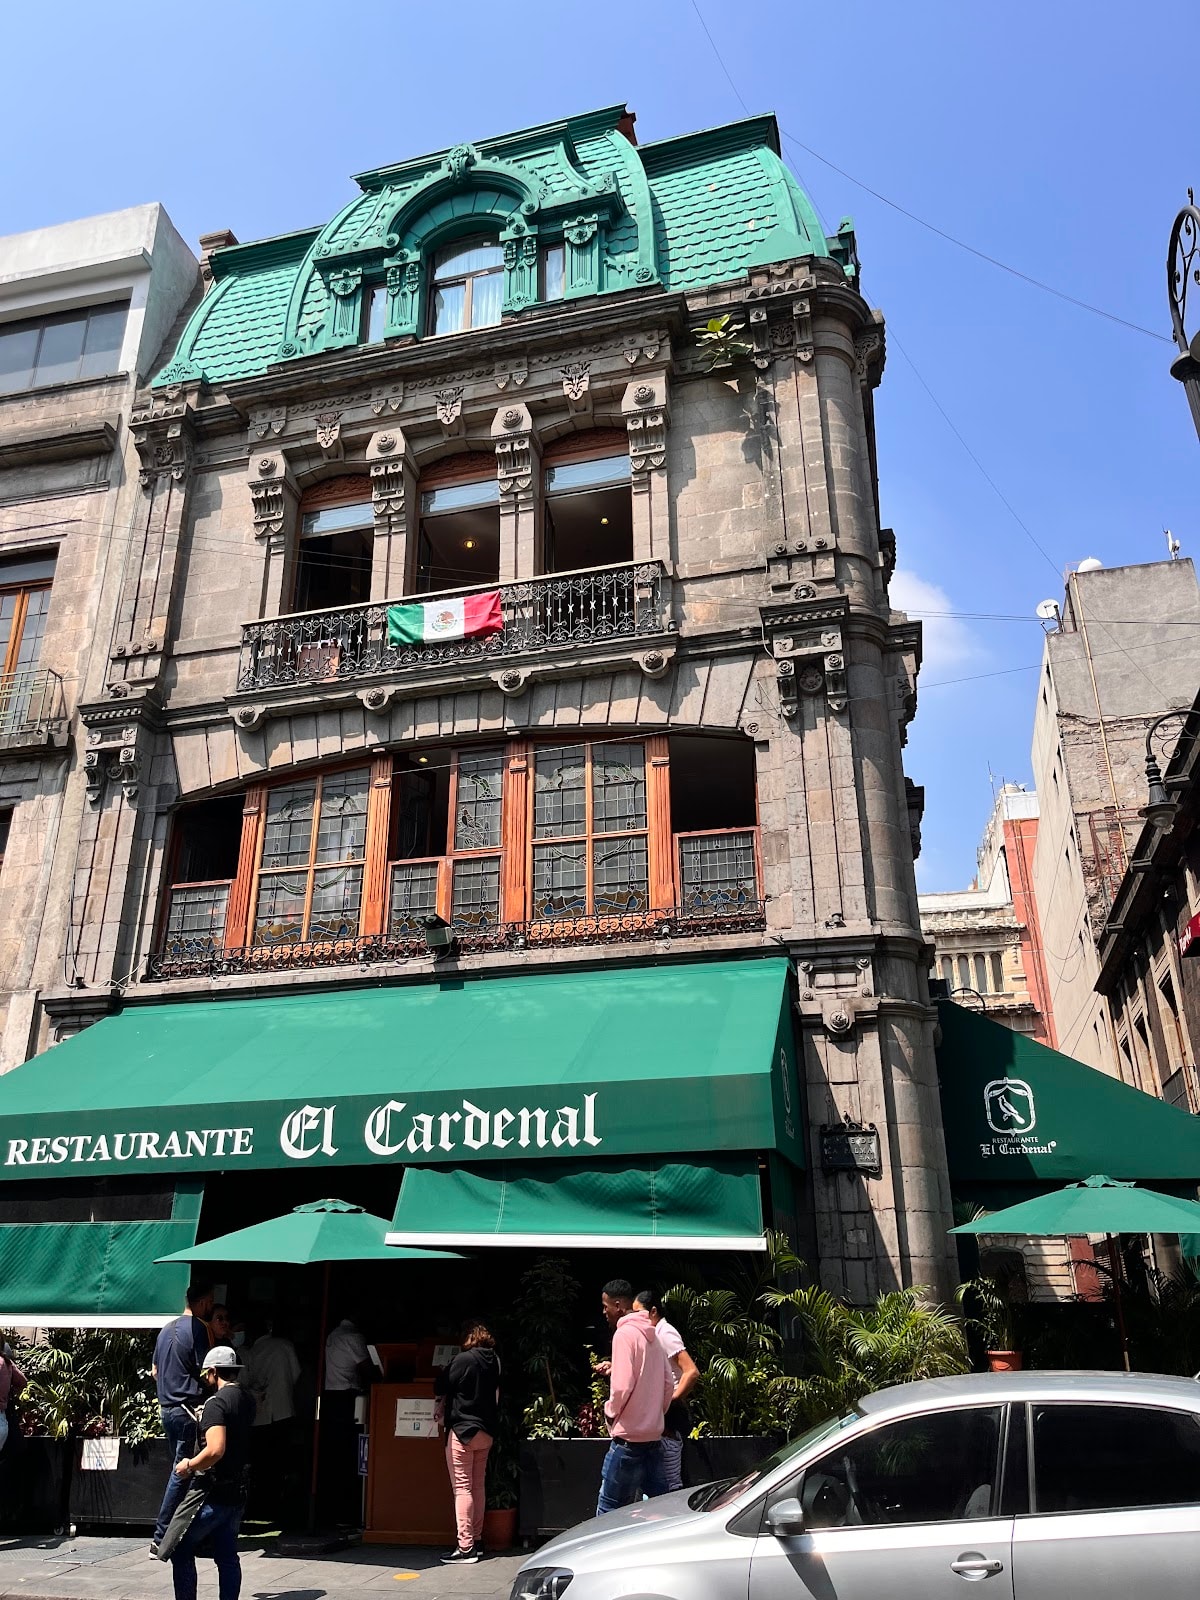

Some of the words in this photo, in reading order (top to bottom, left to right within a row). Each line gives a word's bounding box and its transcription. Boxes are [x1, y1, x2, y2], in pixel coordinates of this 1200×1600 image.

[4, 1128, 253, 1165] RESTAURANTE
[280, 1105, 338, 1159] El
[365, 1092, 602, 1155] Cardenal
[979, 1144, 996, 1158] El
